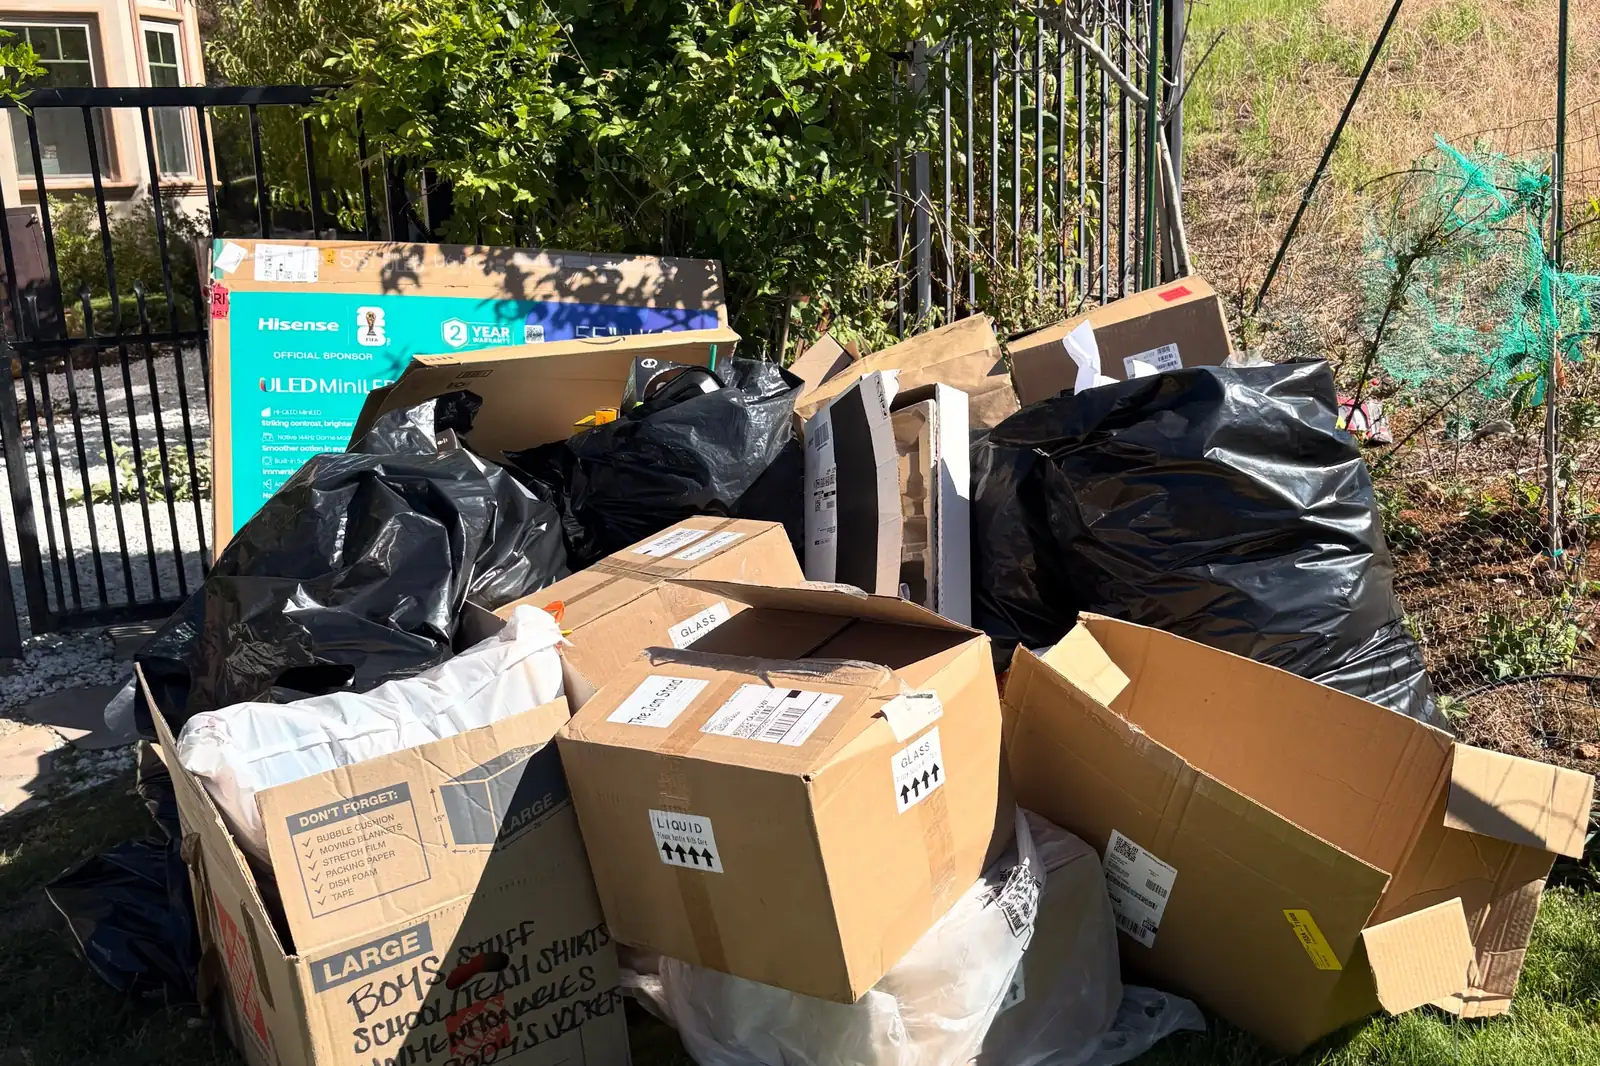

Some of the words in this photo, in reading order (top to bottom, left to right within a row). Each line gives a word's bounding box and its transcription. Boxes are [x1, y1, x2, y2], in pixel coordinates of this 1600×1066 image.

[258, 317, 340, 332] Hisense
[450, 325, 462, 340] 2
[472, 326, 510, 338] YEAR
[273, 351, 320, 360] OFFICIAL
[322, 352, 373, 361] SPONSOR
[259, 377, 318, 393] ULED
[261, 419, 290, 428] Striking
[290, 420, 323, 428] contrast,
[324, 420, 353, 428] brighter
[680, 614, 717, 638] GLASS
[627, 712, 652, 724] The
[656, 679, 683, 698] Stand
[900, 741, 930, 768] GLASS
[298, 806, 340, 828] DON'T
[342, 790, 398, 815] FORGET:
[500, 792, 553, 836] LARGE
[316, 826, 353, 844] BUBBLE
[354, 814, 395, 832] CUSHION
[319, 837, 356, 855] MOVING
[357, 823, 403, 843] BLANKETS
[656, 818, 702, 834] LIQUID
[322, 847, 364, 867] STRETCH
[365, 840, 387, 854] FILM
[325, 860, 365, 878] PACKING
[366, 850, 396, 865] PAPER
[328, 878, 350, 890] DISH
[351, 868, 378, 882] FOAM
[332, 888, 355, 902] TAPE
[322, 931, 421, 984] LARGE
[536, 921, 610, 974] SHIRTS
[348, 954, 445, 1024] BOYS
[457, 920, 535, 967] STUFF
[360, 965, 597, 1066] NMENTIONABLES
